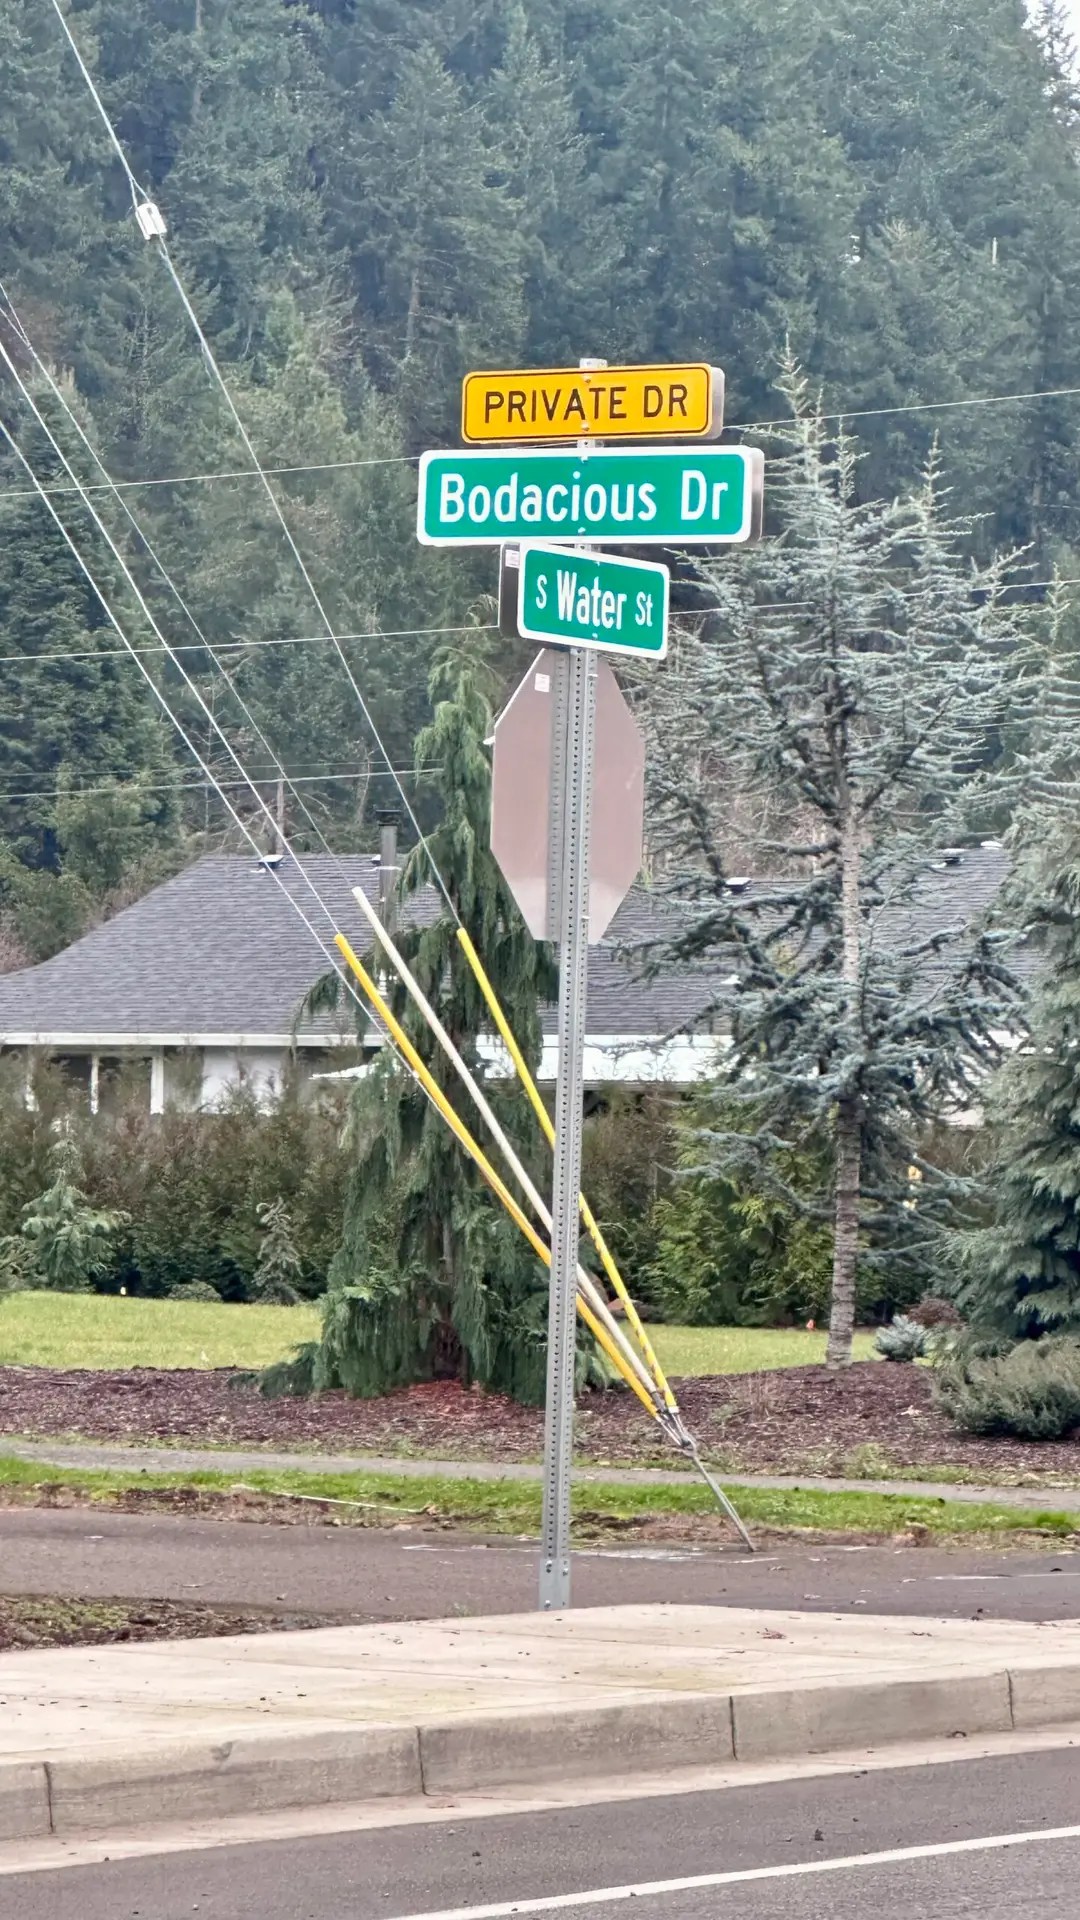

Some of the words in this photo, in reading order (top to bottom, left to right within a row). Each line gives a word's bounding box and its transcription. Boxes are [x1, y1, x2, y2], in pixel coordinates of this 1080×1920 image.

[485, 386, 627, 423] PRIVATE
[643, 384, 688, 418] DR
[440, 471, 657, 523] Bodacious
[681, 470, 729, 521] Dr
[536, 574, 548, 609] S
[557, 569, 627, 630] Water
[635, 591, 653, 627] St
